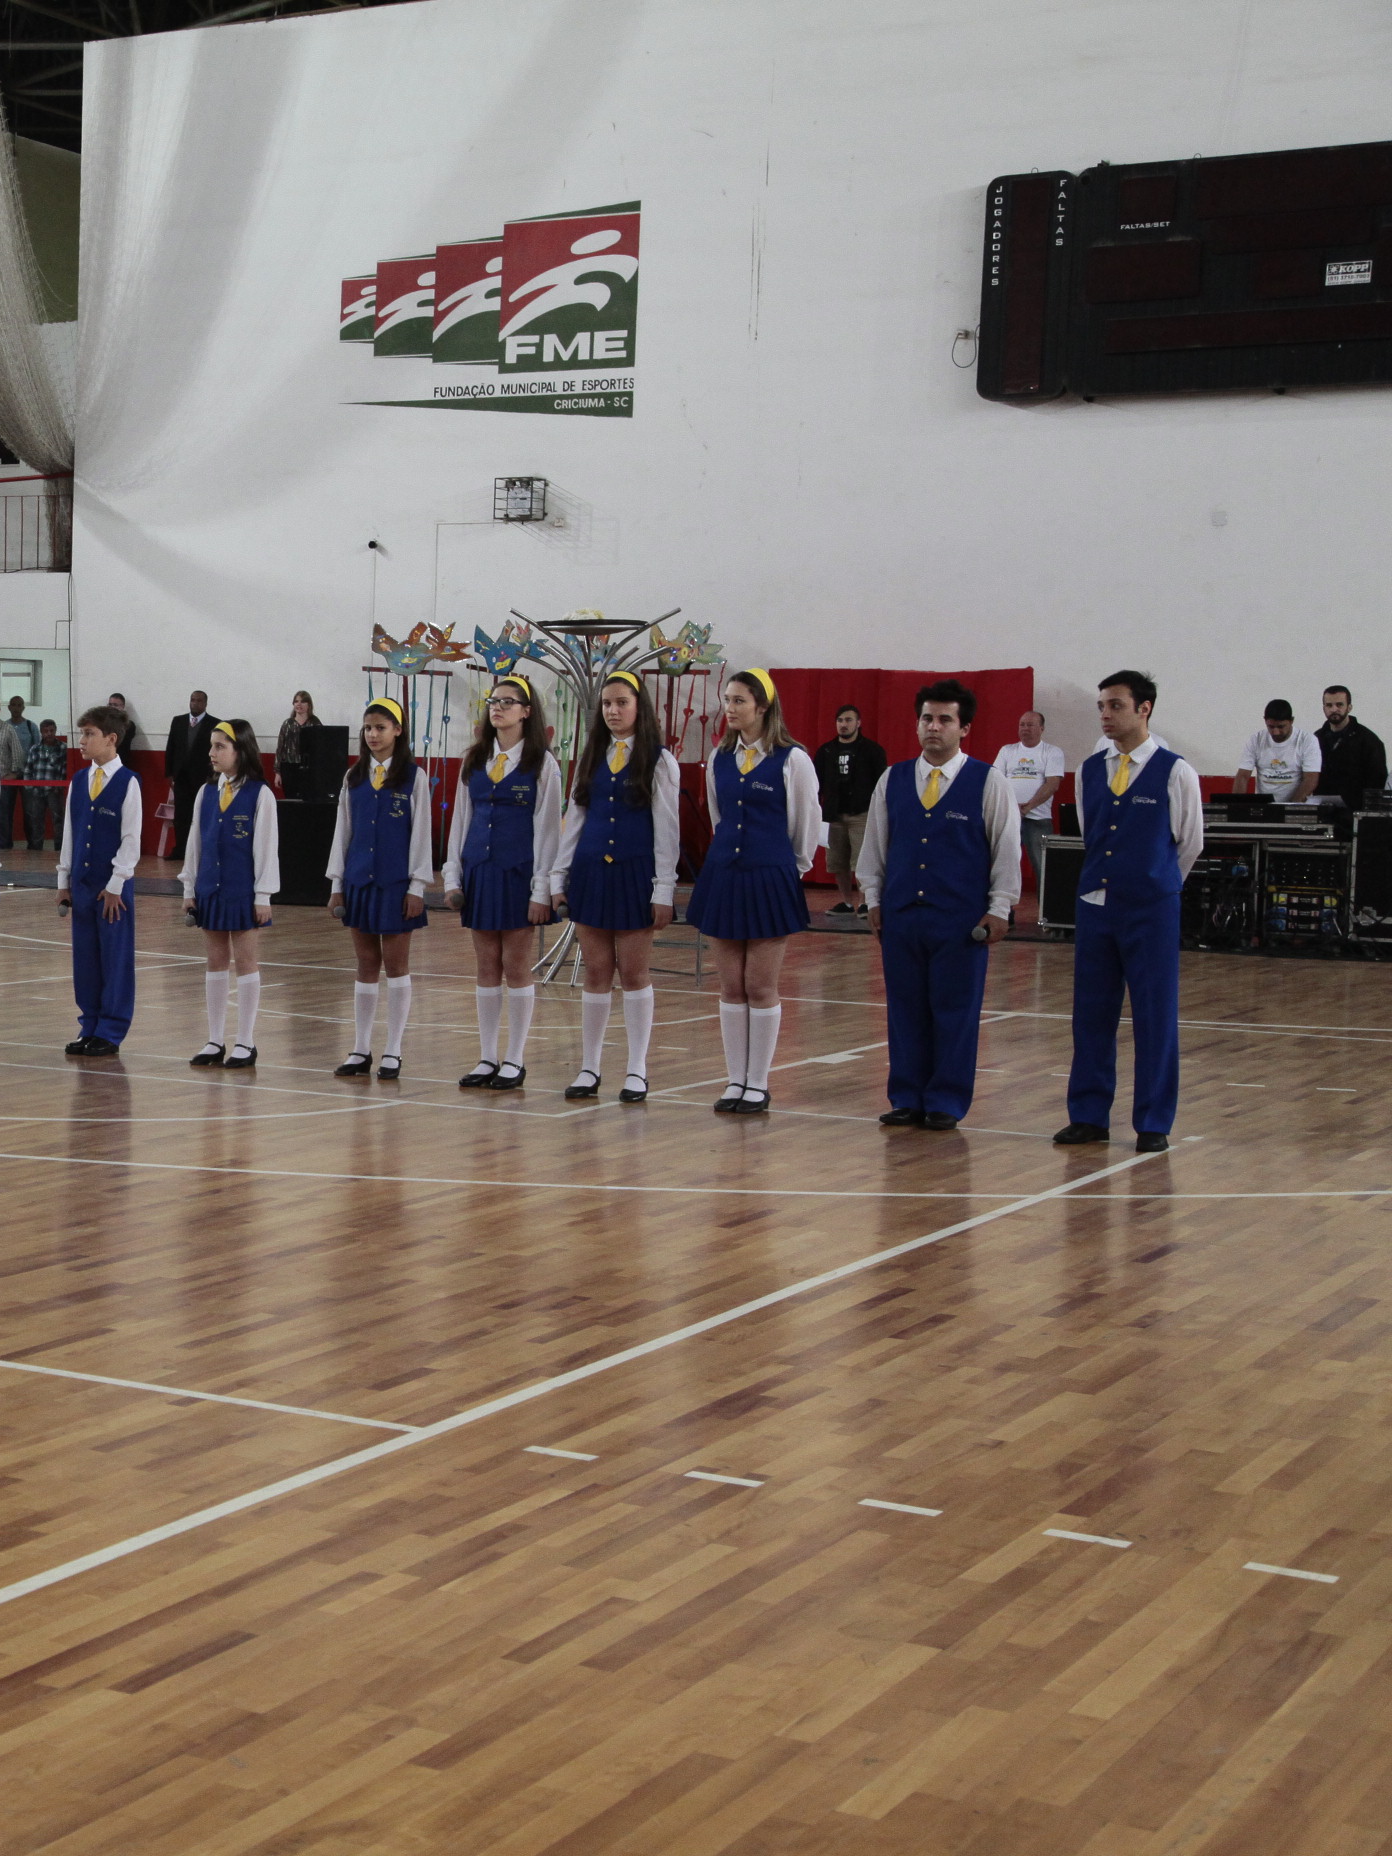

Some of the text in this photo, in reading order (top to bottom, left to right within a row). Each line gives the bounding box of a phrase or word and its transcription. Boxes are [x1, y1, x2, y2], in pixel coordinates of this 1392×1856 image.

[1055, 179, 1067, 246] FALTAS
[991, 185, 1003, 286] JOGADORES
[1120, 221, 1171, 230] FALTAS/SET
[1338, 263, 1369, 273] KOPP
[505, 329, 628, 364] FME
[433, 378, 634, 398] FUNDAÇÃO MUNICIPAL DE ESPORTES
[554, 399, 605, 410] CRICIUMA
[613, 397, 629, 407] SC
